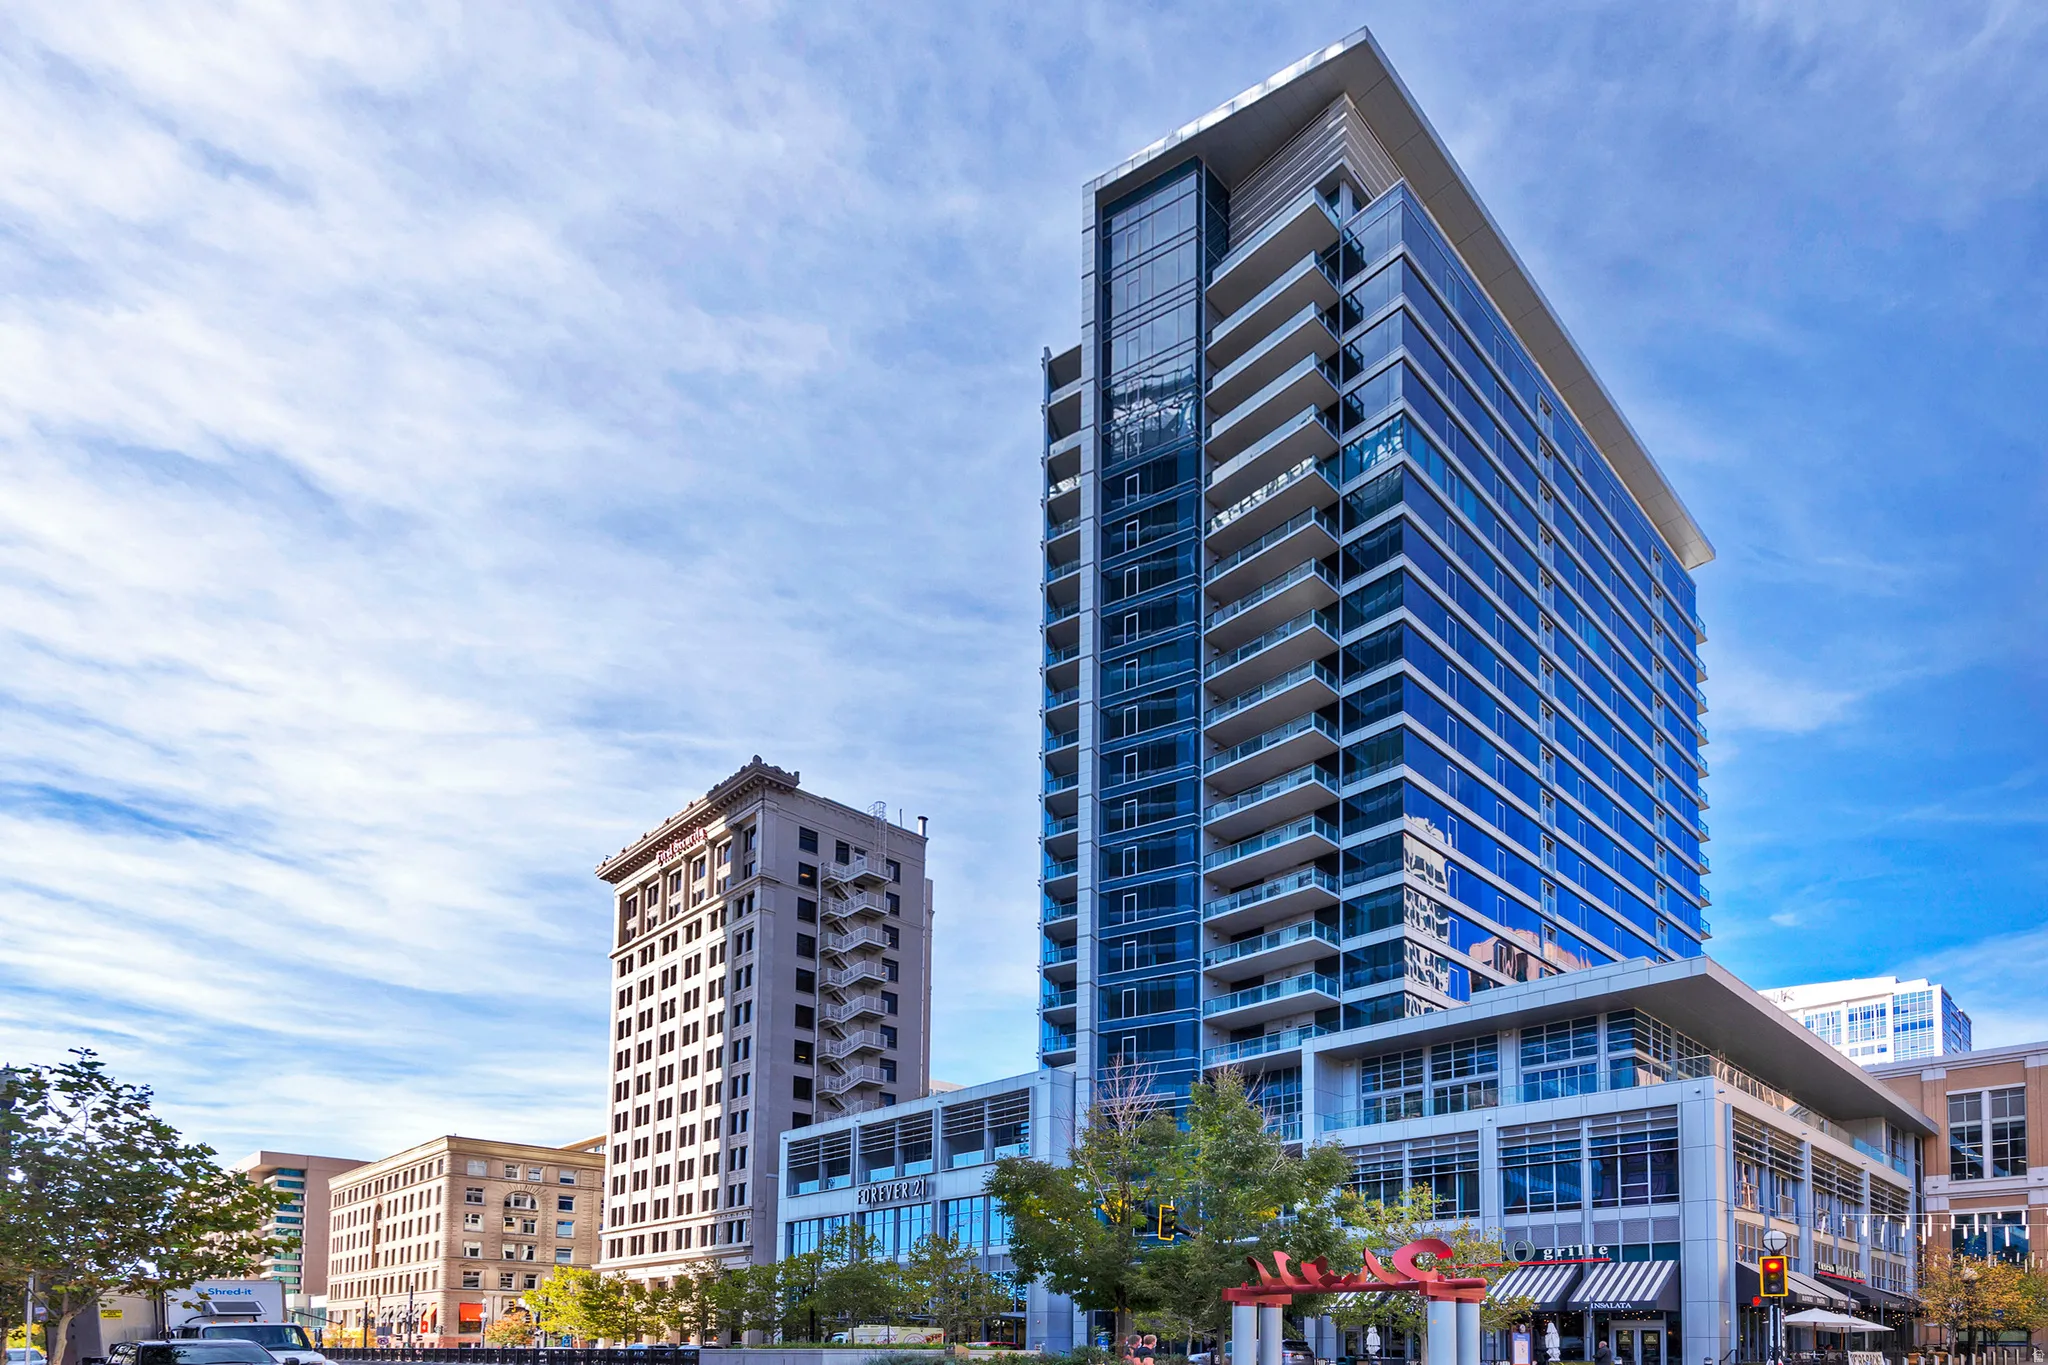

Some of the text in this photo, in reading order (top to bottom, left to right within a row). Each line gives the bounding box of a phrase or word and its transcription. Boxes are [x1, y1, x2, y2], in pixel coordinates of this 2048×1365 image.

[858, 1178, 926, 1204] FOREVER 21
[1543, 1243, 1609, 1261] grille
[207, 1287, 252, 1296] Shred-it
